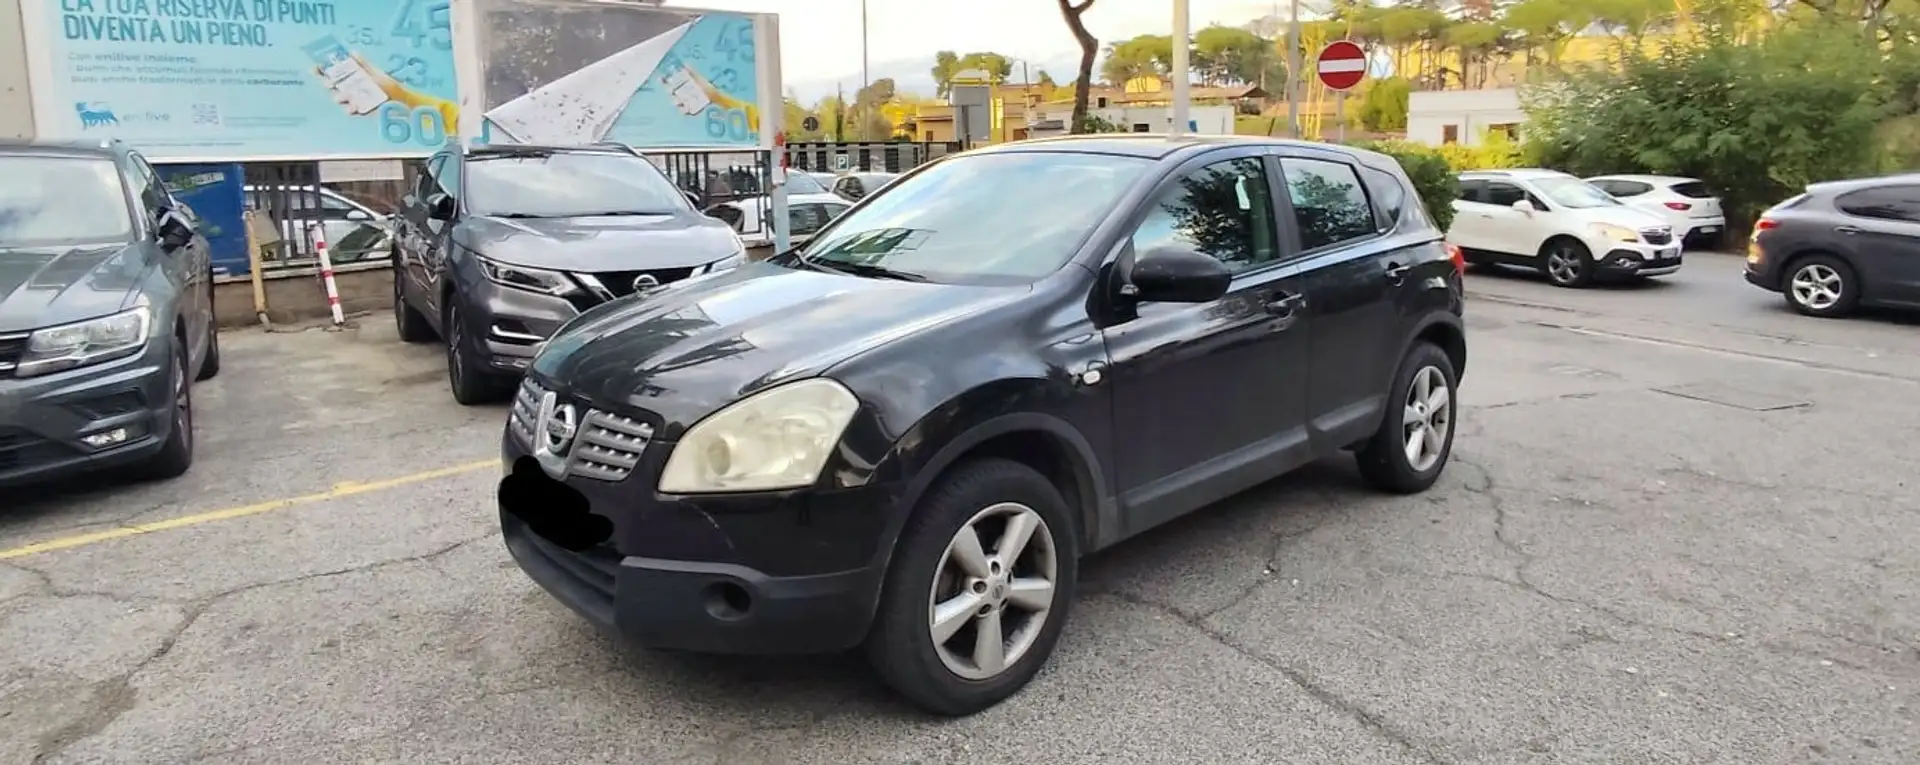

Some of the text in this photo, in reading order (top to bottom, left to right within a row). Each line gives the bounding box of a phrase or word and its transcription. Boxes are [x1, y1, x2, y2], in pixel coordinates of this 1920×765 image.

[60, 0, 337, 26] LA TUA RISERVA DI PUNTI
[63, 14, 274, 48] DIVENTA UN PIENO.
[390, 0, 453, 51] 45
[713, 21, 756, 64] 45
[384, 54, 428, 88] 23
[379, 104, 446, 148] 60
[705, 106, 750, 143] 60
